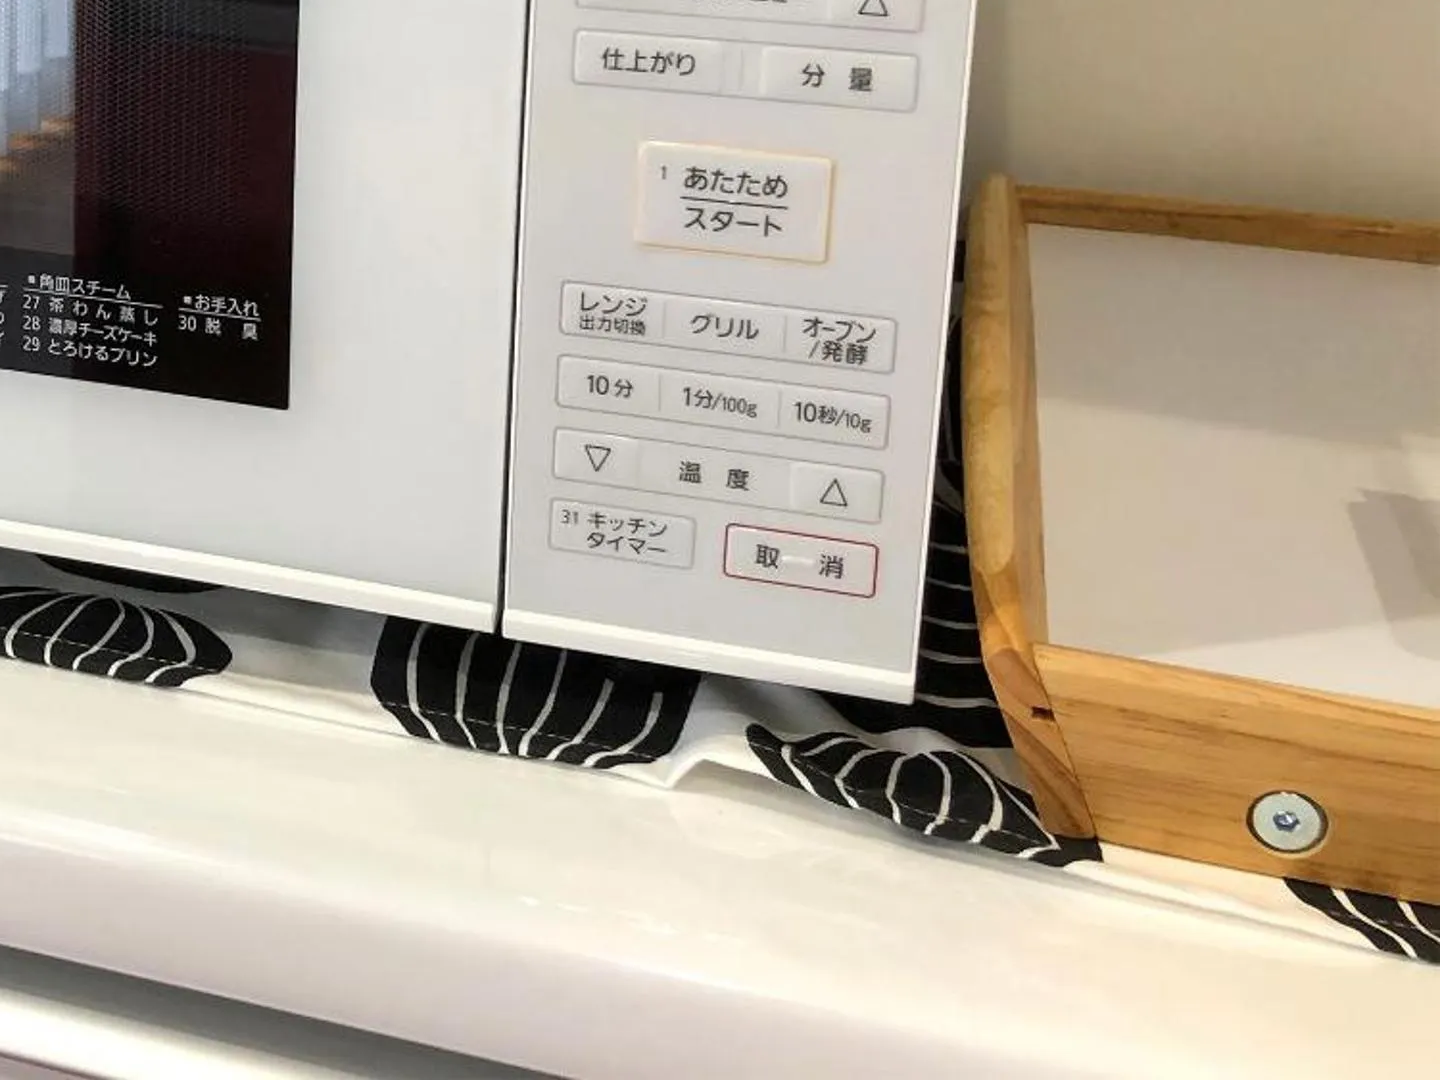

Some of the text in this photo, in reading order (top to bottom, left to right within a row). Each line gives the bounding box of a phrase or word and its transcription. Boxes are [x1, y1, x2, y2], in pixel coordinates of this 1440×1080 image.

[601, 47, 696, 77] 仕上がり
[683, 166, 788, 199] あたため
[683, 207, 782, 237] スタート
[23, 294, 40, 310] 27
[194, 293, 260, 318] お手入れ
[580, 291, 648, 317] レンジ
[23, 314, 40, 331] 28
[178, 314, 197, 332] 30
[691, 314, 759, 339] グリル
[803, 317, 877, 344] オーブン
[23, 335, 40, 352] 29
[683, 386, 757, 418] 1分/100g
[794, 401, 872, 434] 10秒/10g
[561, 508, 668, 538] 31 キッチン
[586, 531, 668, 556] タイマー
